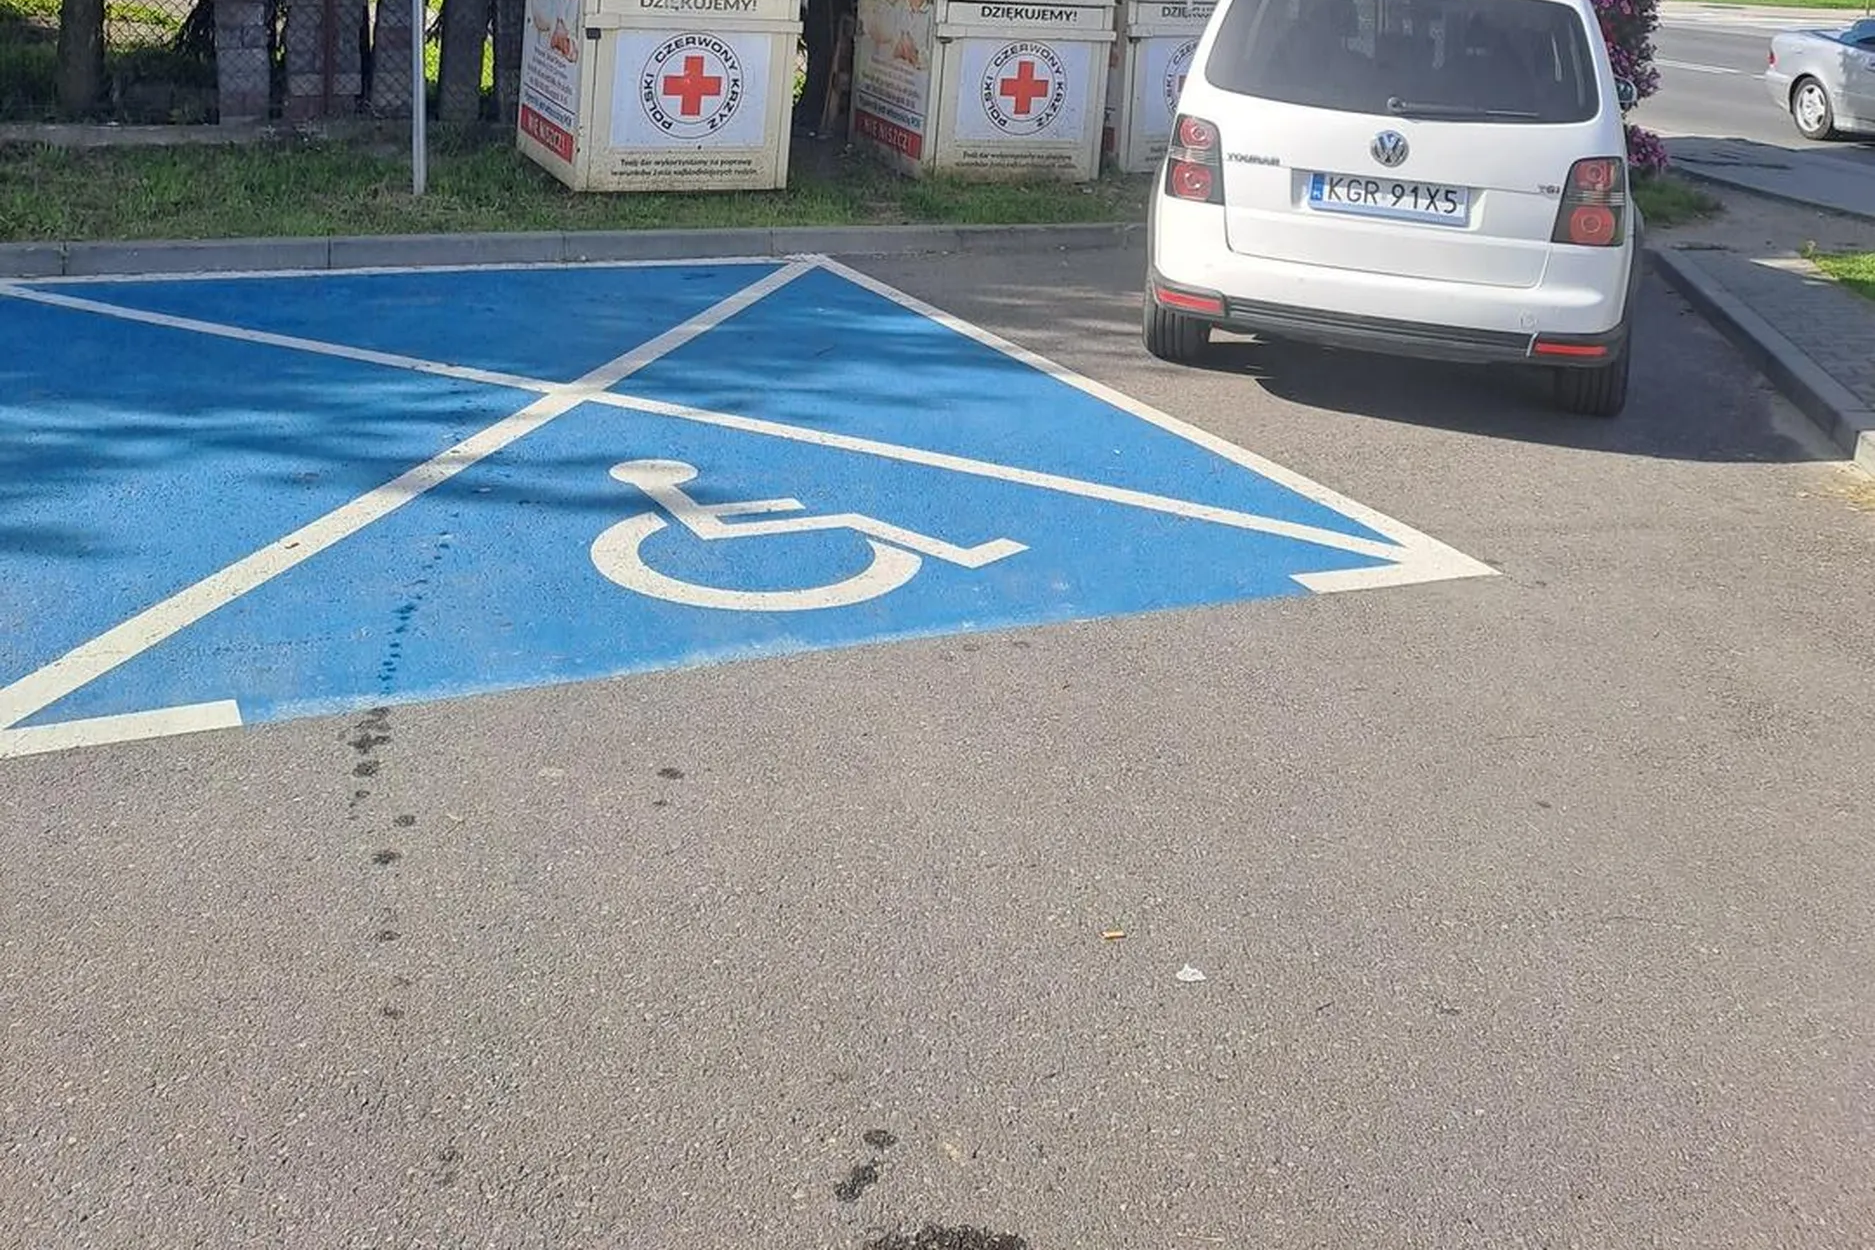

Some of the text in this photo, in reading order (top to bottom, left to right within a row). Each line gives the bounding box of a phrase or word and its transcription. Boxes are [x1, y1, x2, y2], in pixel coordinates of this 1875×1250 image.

[981, 5, 1078, 22] DZIĘKUJEMY!
[654, 36, 738, 71] CZERWONY
[993, 43, 1062, 75] CZERWONY
[643, 73, 674, 130] POLSKI
[984, 75, 1008, 127] POLSKI
[1328, 176, 1458, 214] KGR 91X5
